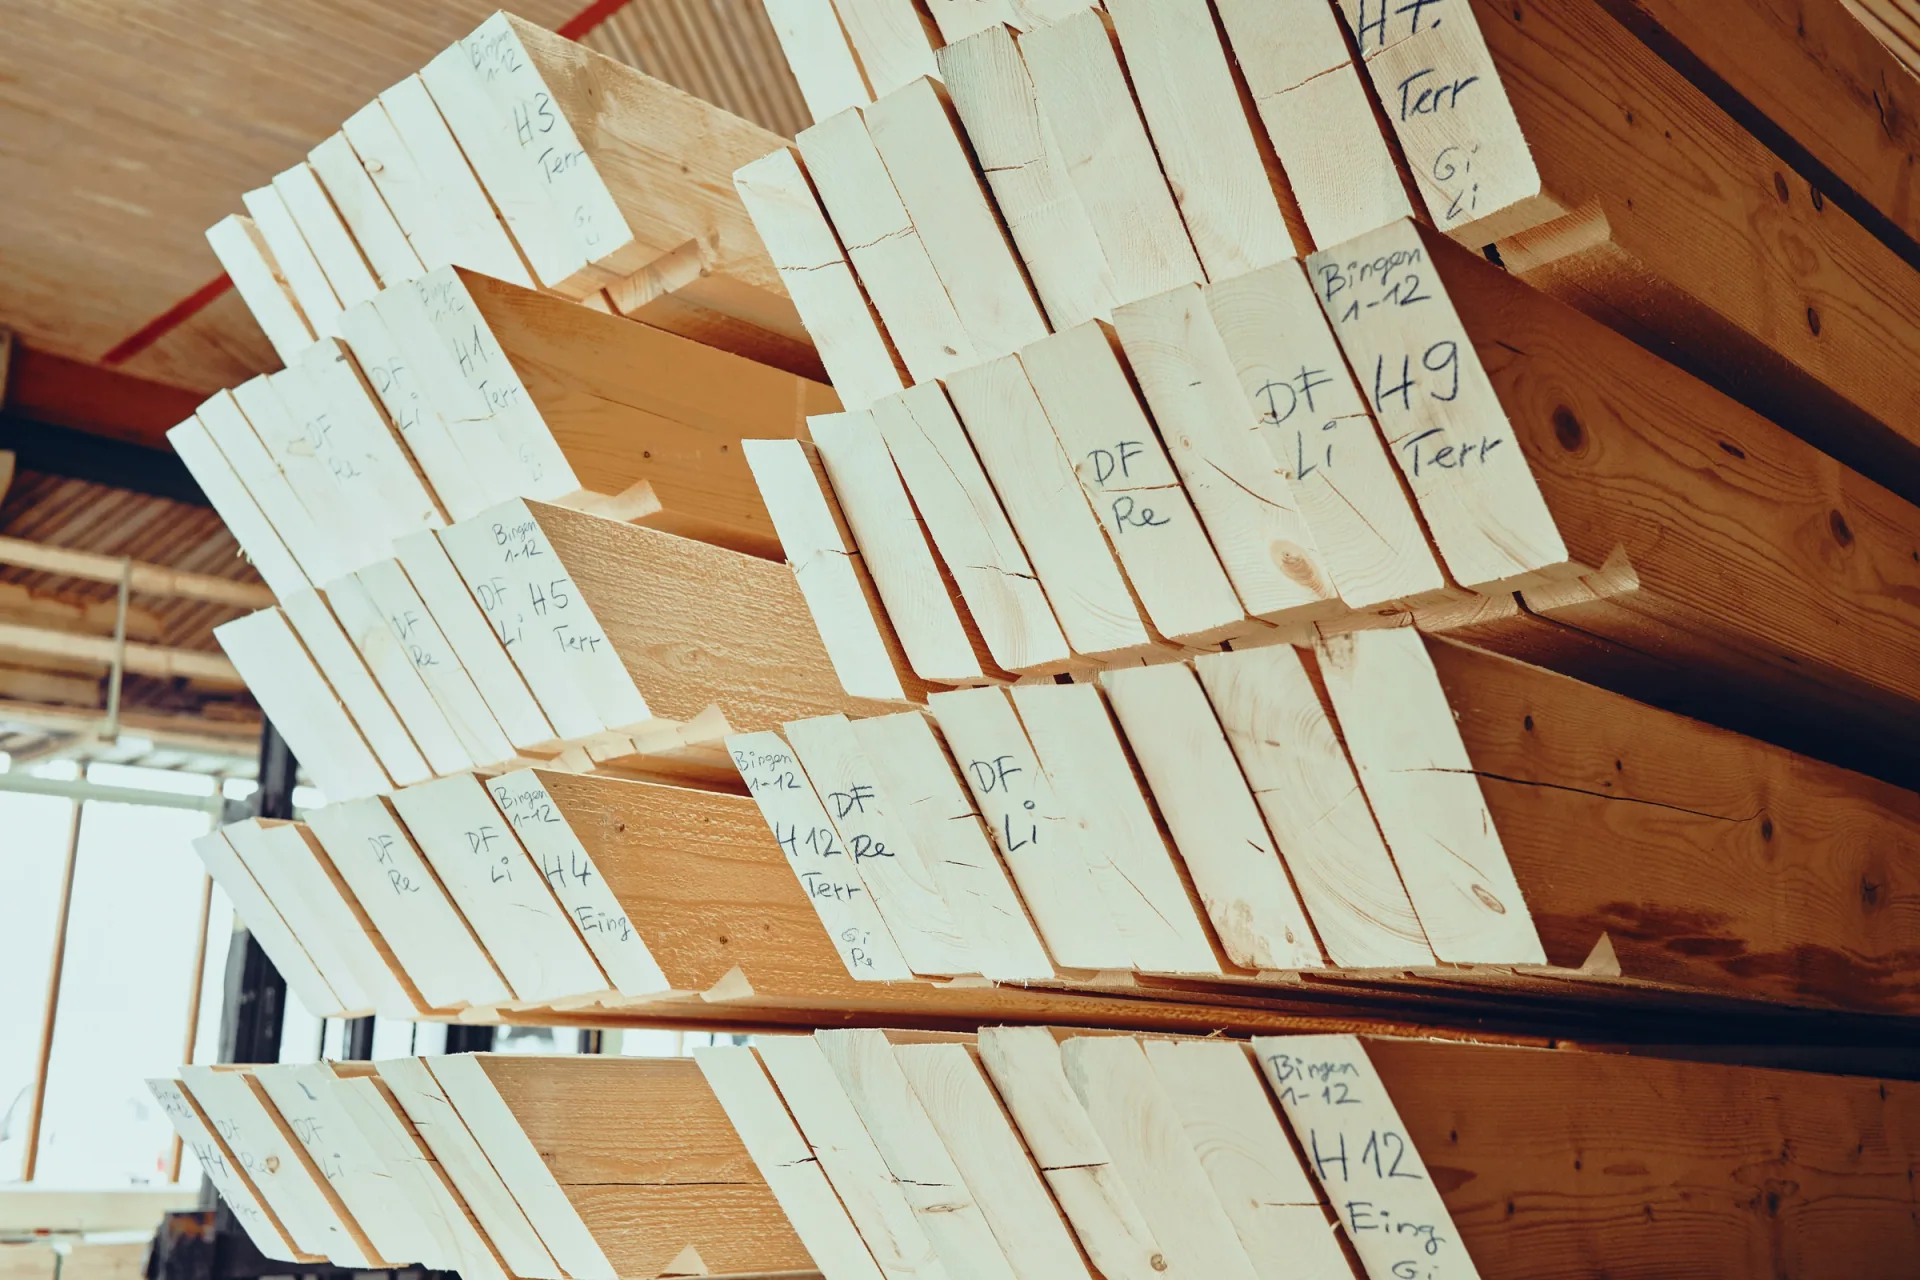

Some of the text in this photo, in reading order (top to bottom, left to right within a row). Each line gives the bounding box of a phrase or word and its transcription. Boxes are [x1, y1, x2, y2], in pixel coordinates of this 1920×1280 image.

[1398, 67, 1480, 122] Terr
[513, 92, 555, 147] H3
[538, 147, 585, 184] Terr
[1317, 246, 1423, 303] Bingen
[1341, 274, 1432, 323] 1-12
[372, 357, 404, 393] DF
[1374, 340, 1461, 414] H9
[478, 380, 518, 414] Terr
[1255, 365, 1334, 426] DF
[1086, 440, 1145, 486] DF
[1296, 420, 1340, 480] Li
[1402, 427, 1504, 477] Terr
[492, 519, 538, 546] Bingen
[1111, 495, 1171, 534] Re
[504, 539, 543, 563] 1-12
[477, 576, 507, 612] DF
[528, 578, 569, 616] H5
[391, 610, 419, 641] DF
[500, 613, 523, 648] Li
[552, 625, 601, 653] Terr
[733, 750, 792, 772] Bingen
[969, 755, 1022, 793] DF
[494, 786, 547, 810] Bingen
[749, 771, 801, 790] 1-12
[513, 804, 560, 828] 1-12
[828, 783, 875, 820] DF
[465, 826, 499, 855] DF
[1004, 800, 1037, 852] Li
[368, 834, 394, 865] DF
[850, 834, 895, 865] Re
[491, 856, 513, 883] Li
[801, 872, 861, 900] Terr
[574, 906, 631, 942] Eing
[1268, 1055, 1360, 1083] Bingen
[293, 1116, 324, 1146] DF
[191, 1141, 228, 1178] H4
[322, 1152, 345, 1179] Li
[1345, 1200, 1447, 1256] Eing
